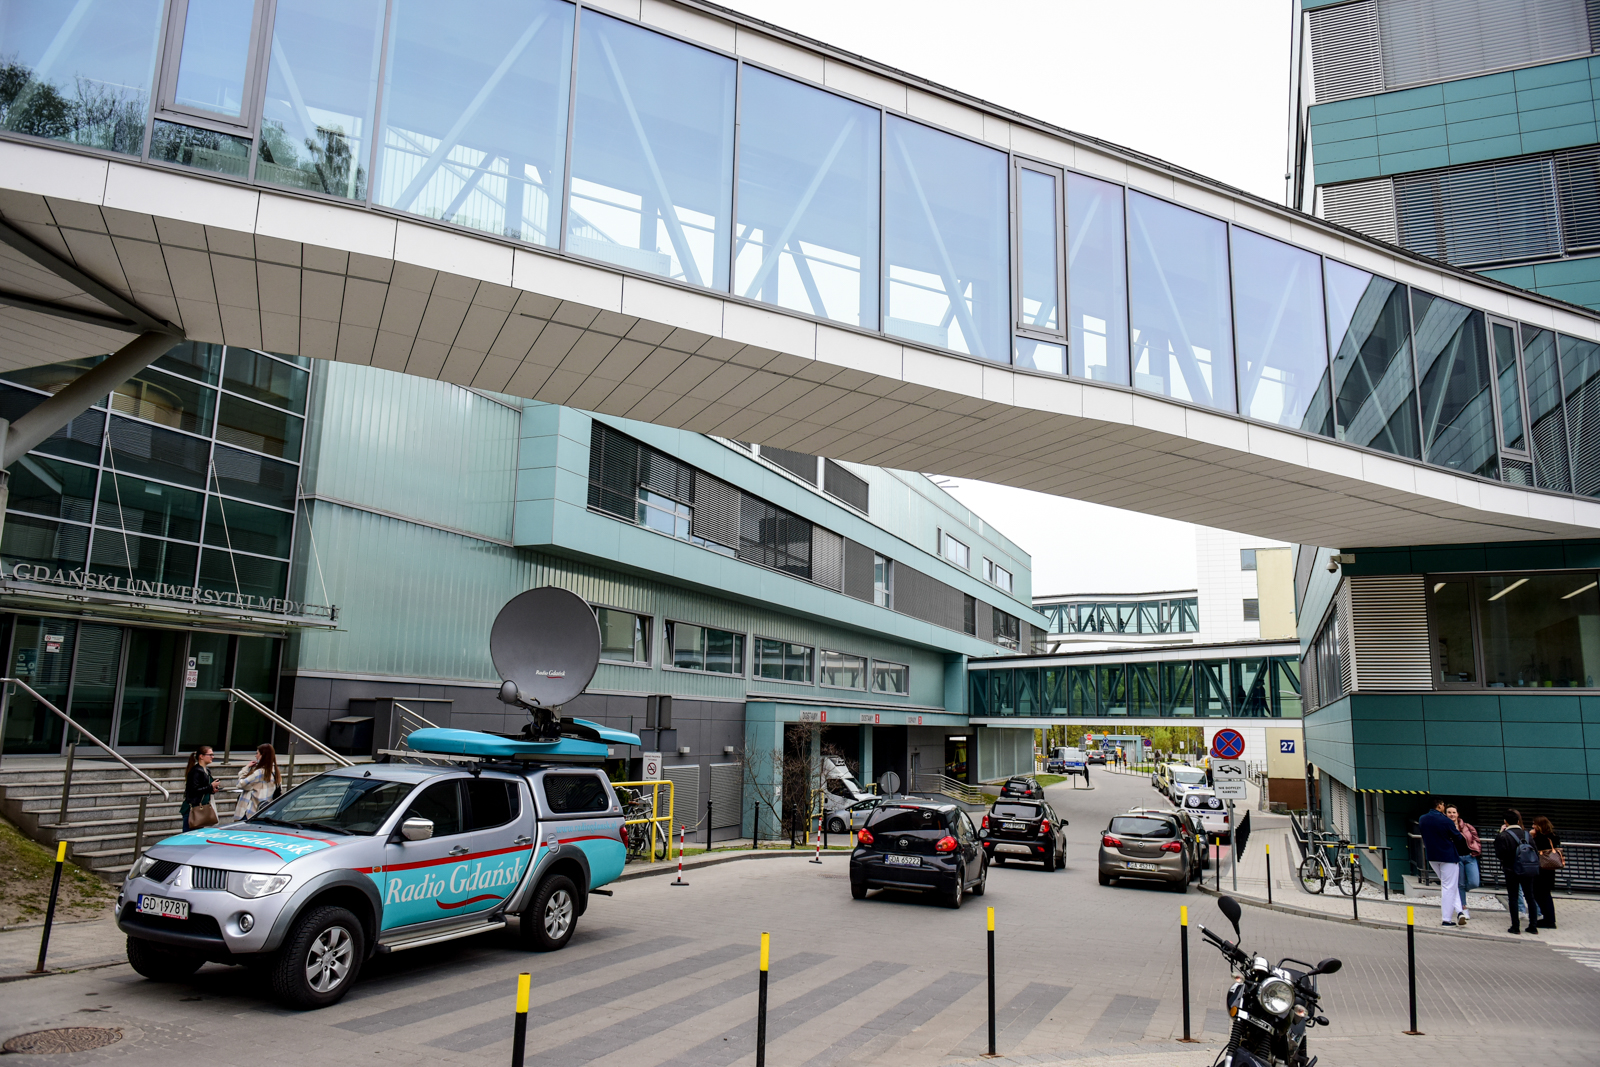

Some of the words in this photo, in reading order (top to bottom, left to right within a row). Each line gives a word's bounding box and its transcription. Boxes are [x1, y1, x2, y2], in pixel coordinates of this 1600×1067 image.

[13, 563, 120, 592] GDAŃSKI
[126, 578, 256, 608] UNIWERSYTET
[259, 596, 342, 619] MEDYCZNY
[548, 669, 566, 677] Gdańsk
[1281, 742, 1294, 751] 27
[556, 821, 618, 834] www.radiogdansk.pl
[183, 830, 229, 839] Radio
[229, 834, 314, 855] Gdańsk
[901, 857, 920, 865] 65222
[384, 872, 446, 905] Radio
[449, 857, 525, 894] Gdańsk
[143, 897, 156, 910] GD
[160, 900, 186, 915] 1978Y
